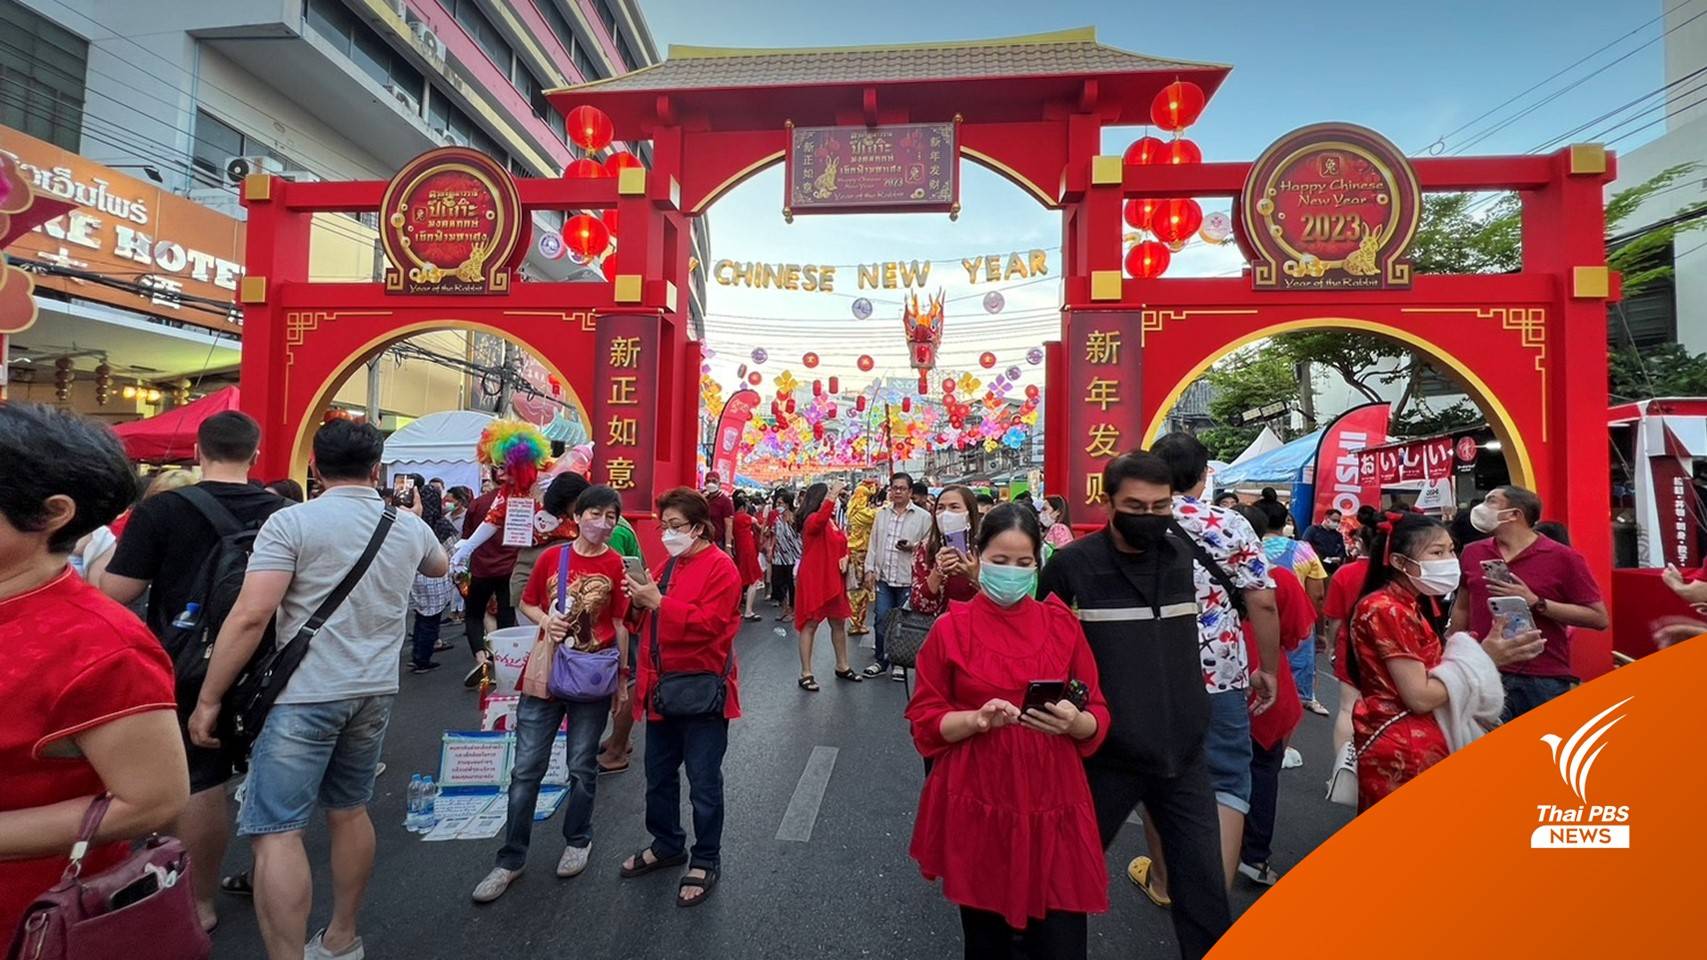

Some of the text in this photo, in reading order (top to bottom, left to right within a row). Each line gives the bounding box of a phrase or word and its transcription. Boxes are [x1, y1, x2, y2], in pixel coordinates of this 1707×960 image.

[1279, 179, 1384, 193] Happy Chinese
[1298, 194, 1367, 208] New Year
[1301, 214, 1361, 241] 2023
[114, 224, 246, 290] HOTE
[713, 258, 836, 292] CHINESE
[857, 259, 932, 289] NEW
[961, 248, 1049, 284] YEAR
[409, 284, 431, 293] Year
[1284, 278, 1378, 288] Year of the Rabbit
[606, 336, 641, 489] 新正如意
